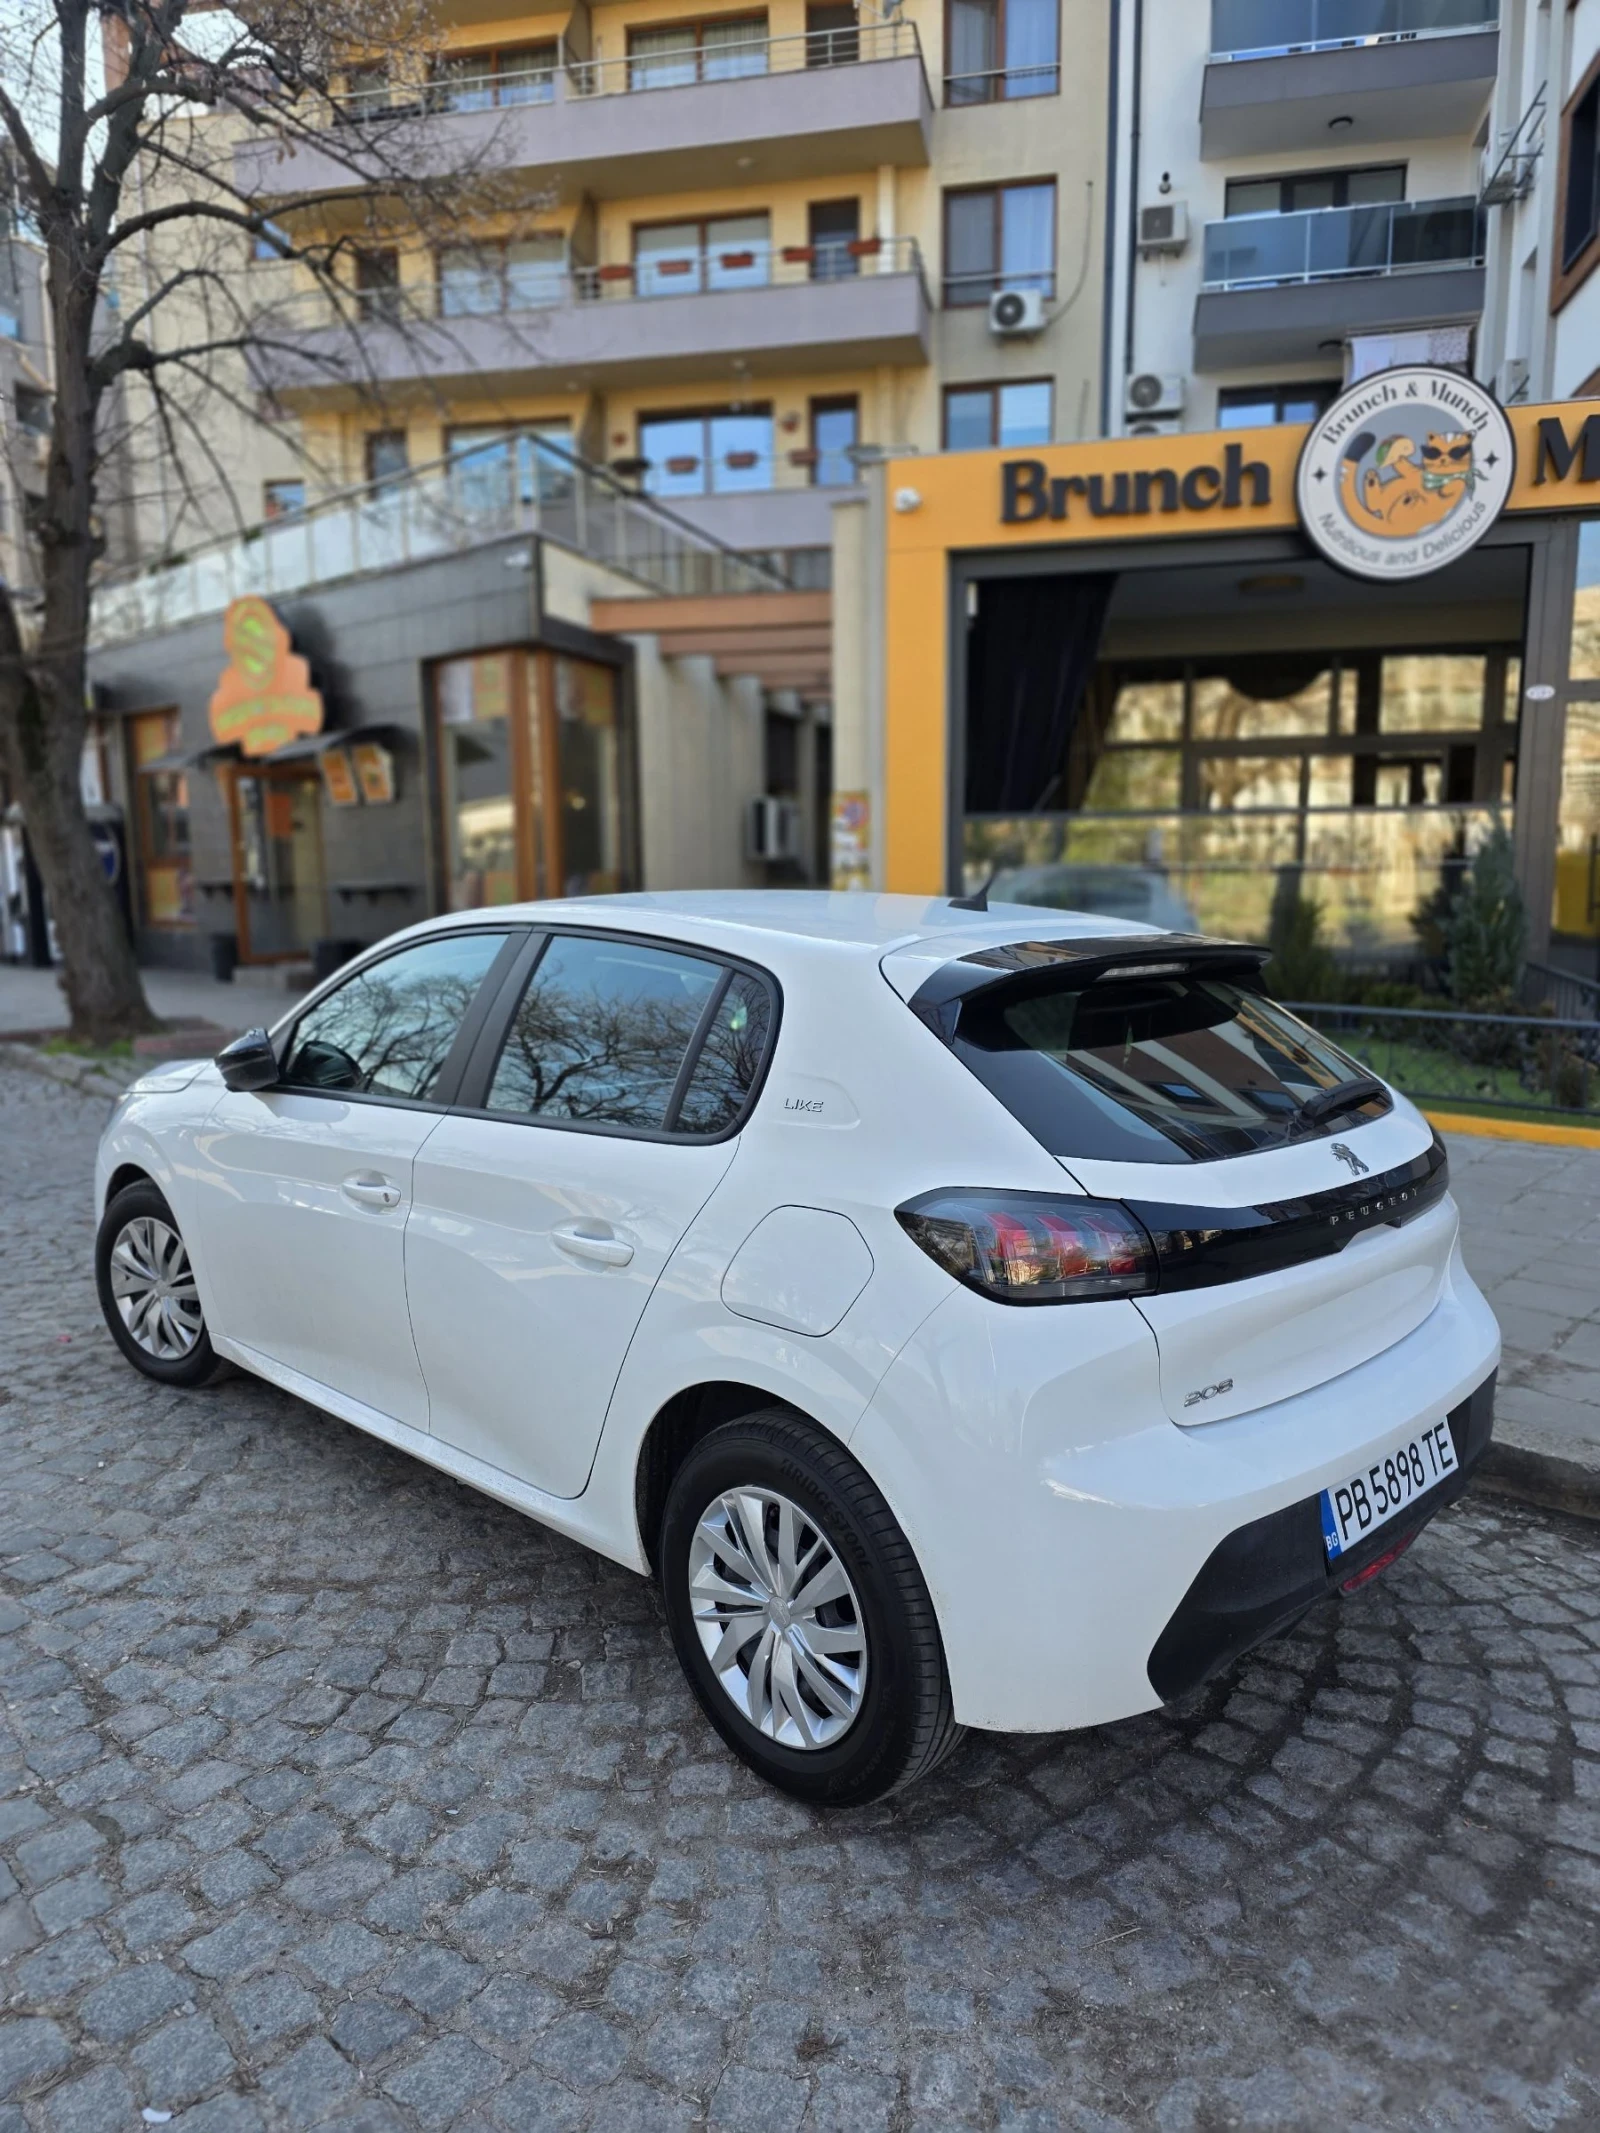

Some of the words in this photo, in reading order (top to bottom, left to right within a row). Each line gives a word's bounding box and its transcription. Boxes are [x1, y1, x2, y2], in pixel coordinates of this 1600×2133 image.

[1322, 384, 1398, 445] Brunch
[1405, 381, 1419, 398] &
[1429, 380, 1490, 431] Munch
[1001, 443, 1272, 524] Brunch
[1384, 549, 1418, 567] and
[1423, 500, 1487, 559] Delicious
[784, 1098, 824, 1112] LIKE
[1184, 1378, 1234, 1408] 208
[1335, 1478, 1372, 1541] PB
[1369, 1442, 1425, 1515] 5898
[1421, 1422, 1453, 1476] TE
[1326, 1532, 1339, 1550] BG
